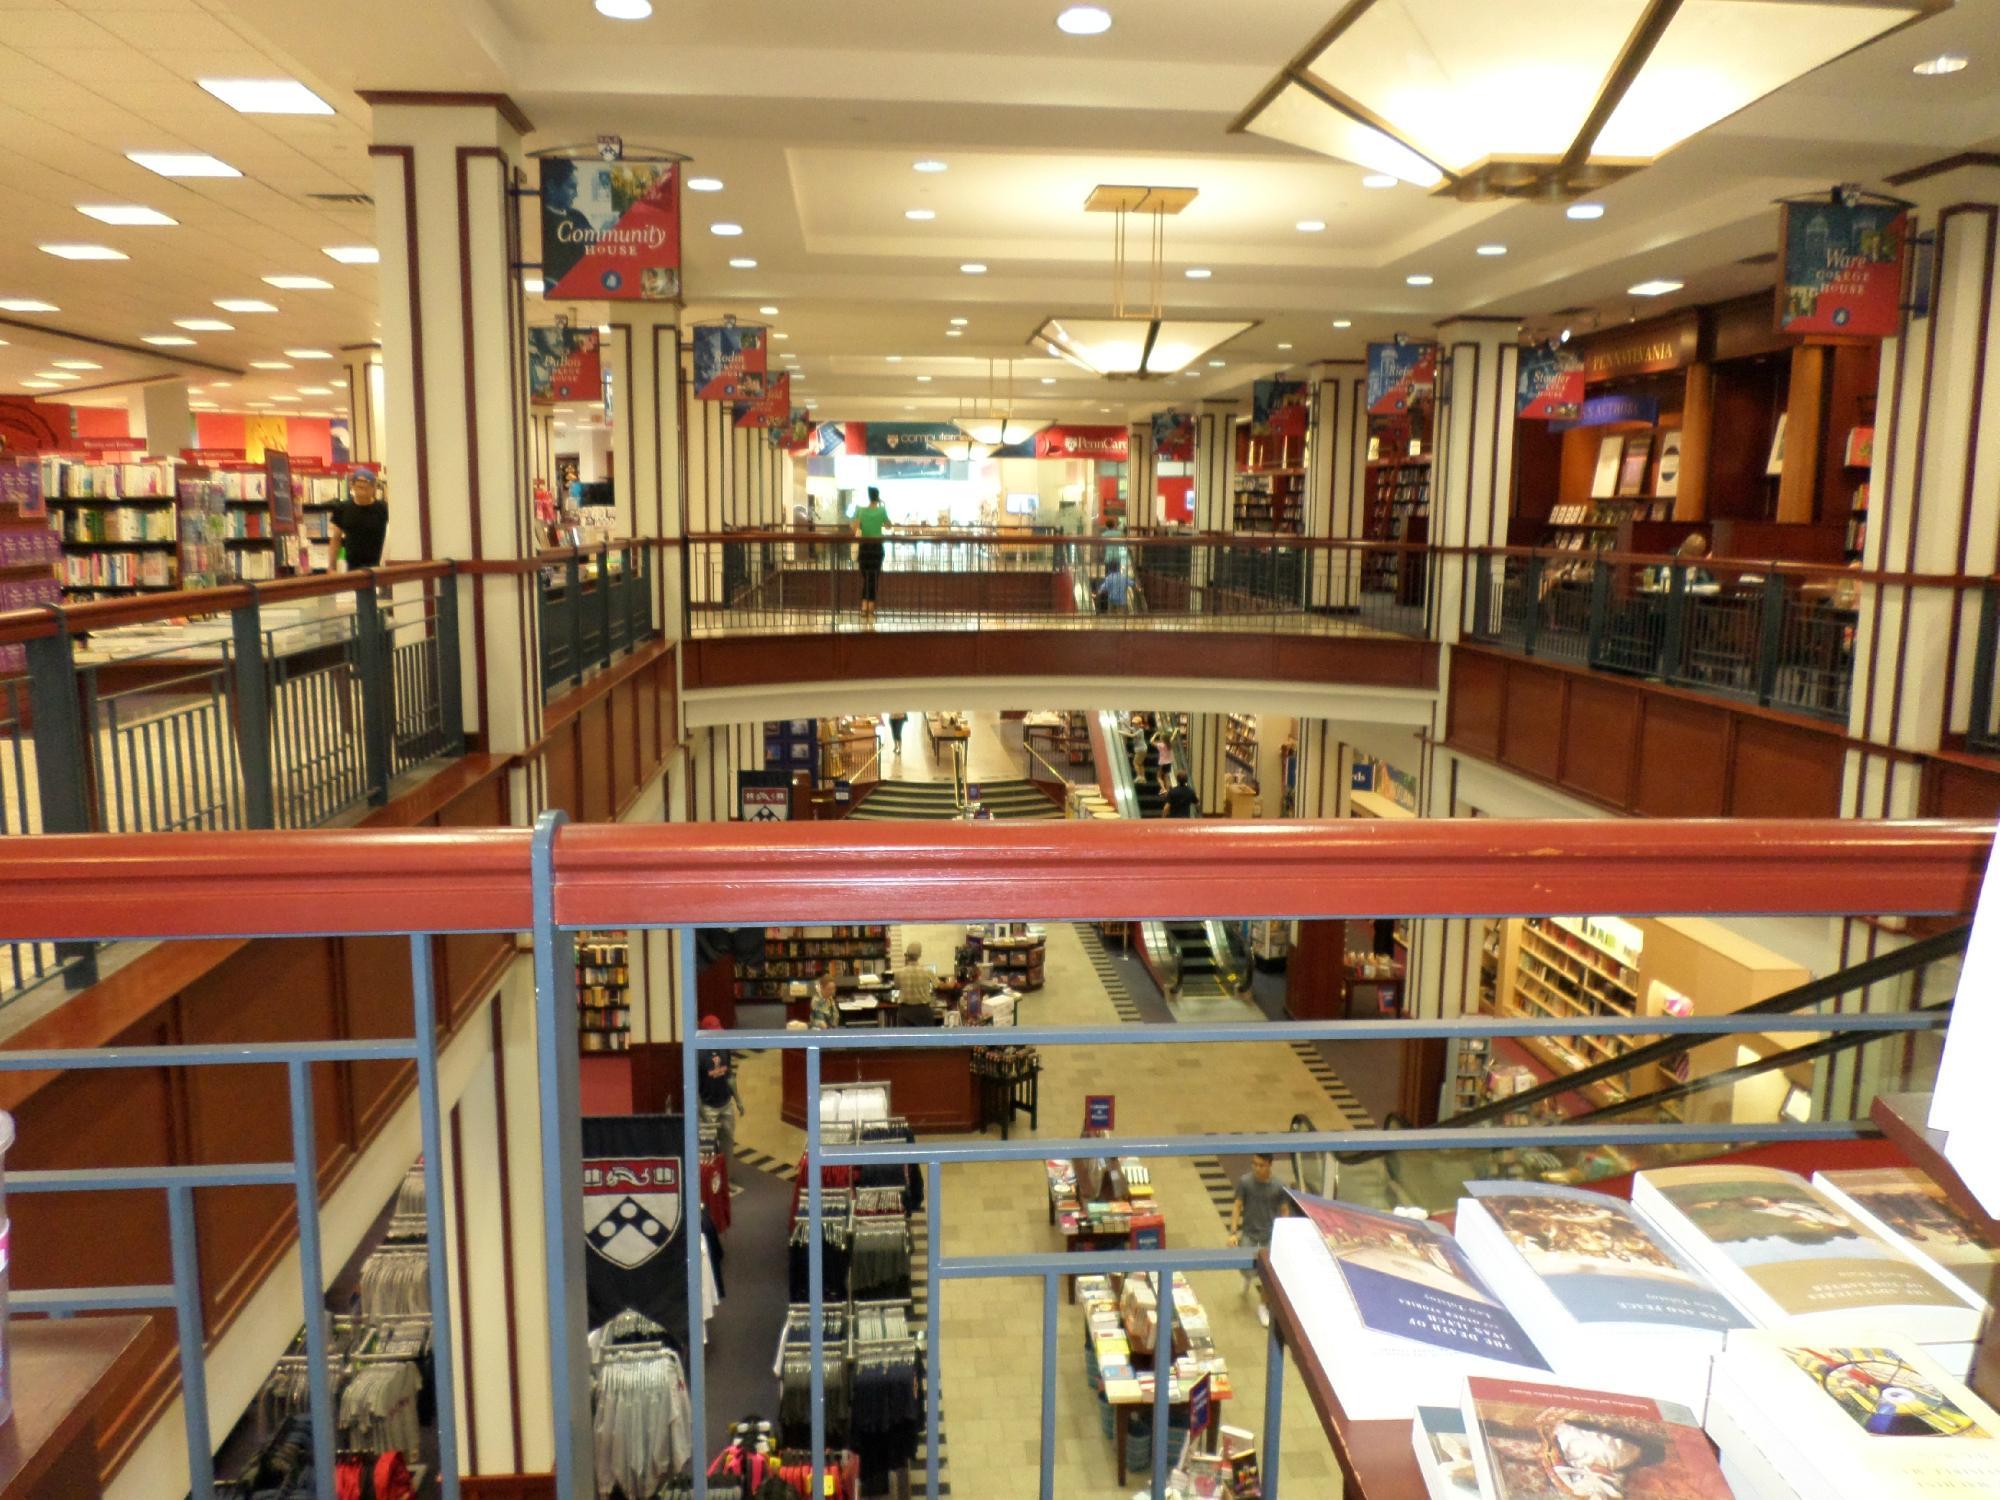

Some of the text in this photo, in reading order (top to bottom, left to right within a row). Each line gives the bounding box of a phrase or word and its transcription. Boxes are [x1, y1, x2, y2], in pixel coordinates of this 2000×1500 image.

[557, 220, 665, 248] Community
[585, 245, 638, 256] HOUSE
[1826, 248, 1867, 268] Ware
[1820, 283, 1865, 295] HOUSE
[1592, 342, 1673, 371] PENNSYLVANIA
[1398, 1298, 1442, 1314] STORIES
[1424, 1293, 1467, 1312] Tolstoy
[1408, 1317, 1512, 1351] THE DEATH OF
[1474, 1327, 1507, 1341] IVAN
